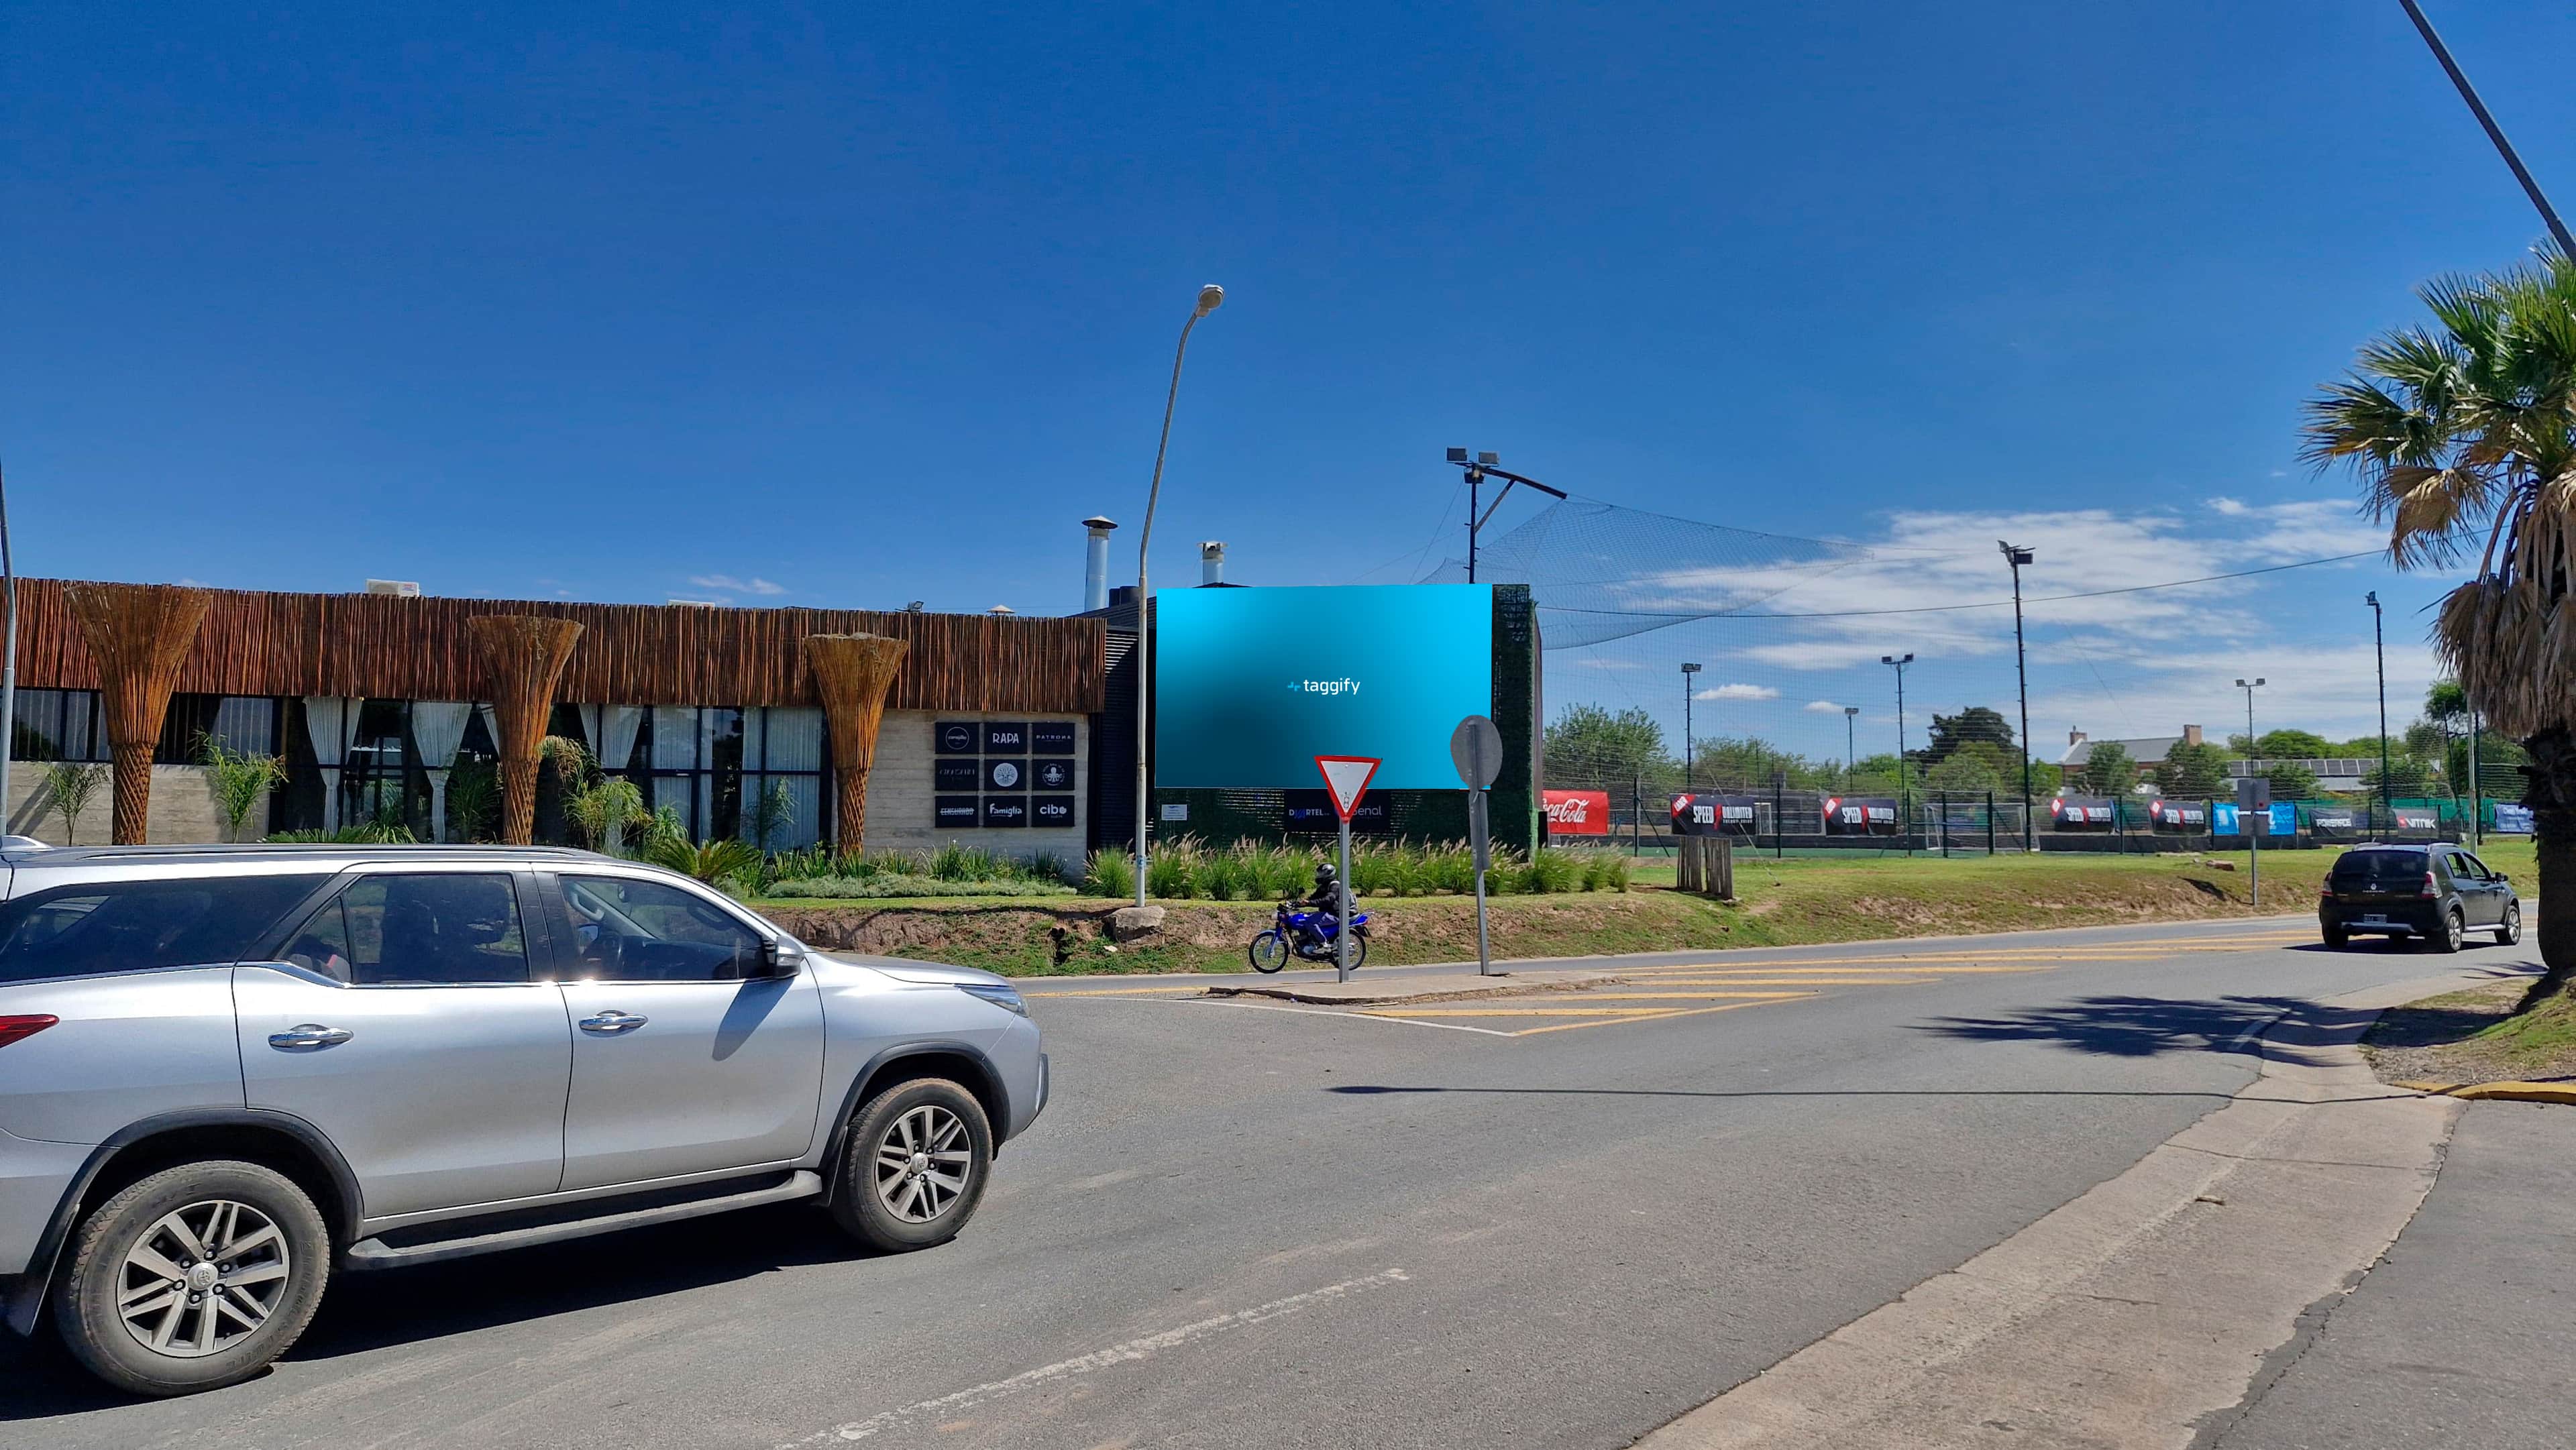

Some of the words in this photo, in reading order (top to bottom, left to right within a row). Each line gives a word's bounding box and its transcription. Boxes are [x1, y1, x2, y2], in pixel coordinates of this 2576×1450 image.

[1303, 677, 1360, 695] taggify
[993, 733, 1019, 744] RAPA
[989, 803, 1022, 818] Famiglia
[1040, 803, 1067, 814] cibo
[1352, 805, 1383, 816] senal
[1543, 798, 1589, 823] oca-Cola
[1693, 805, 1714, 824] SPEED
[1722, 806, 1753, 819] UNLIMITED
[1841, 807, 1862, 824] SPEED
